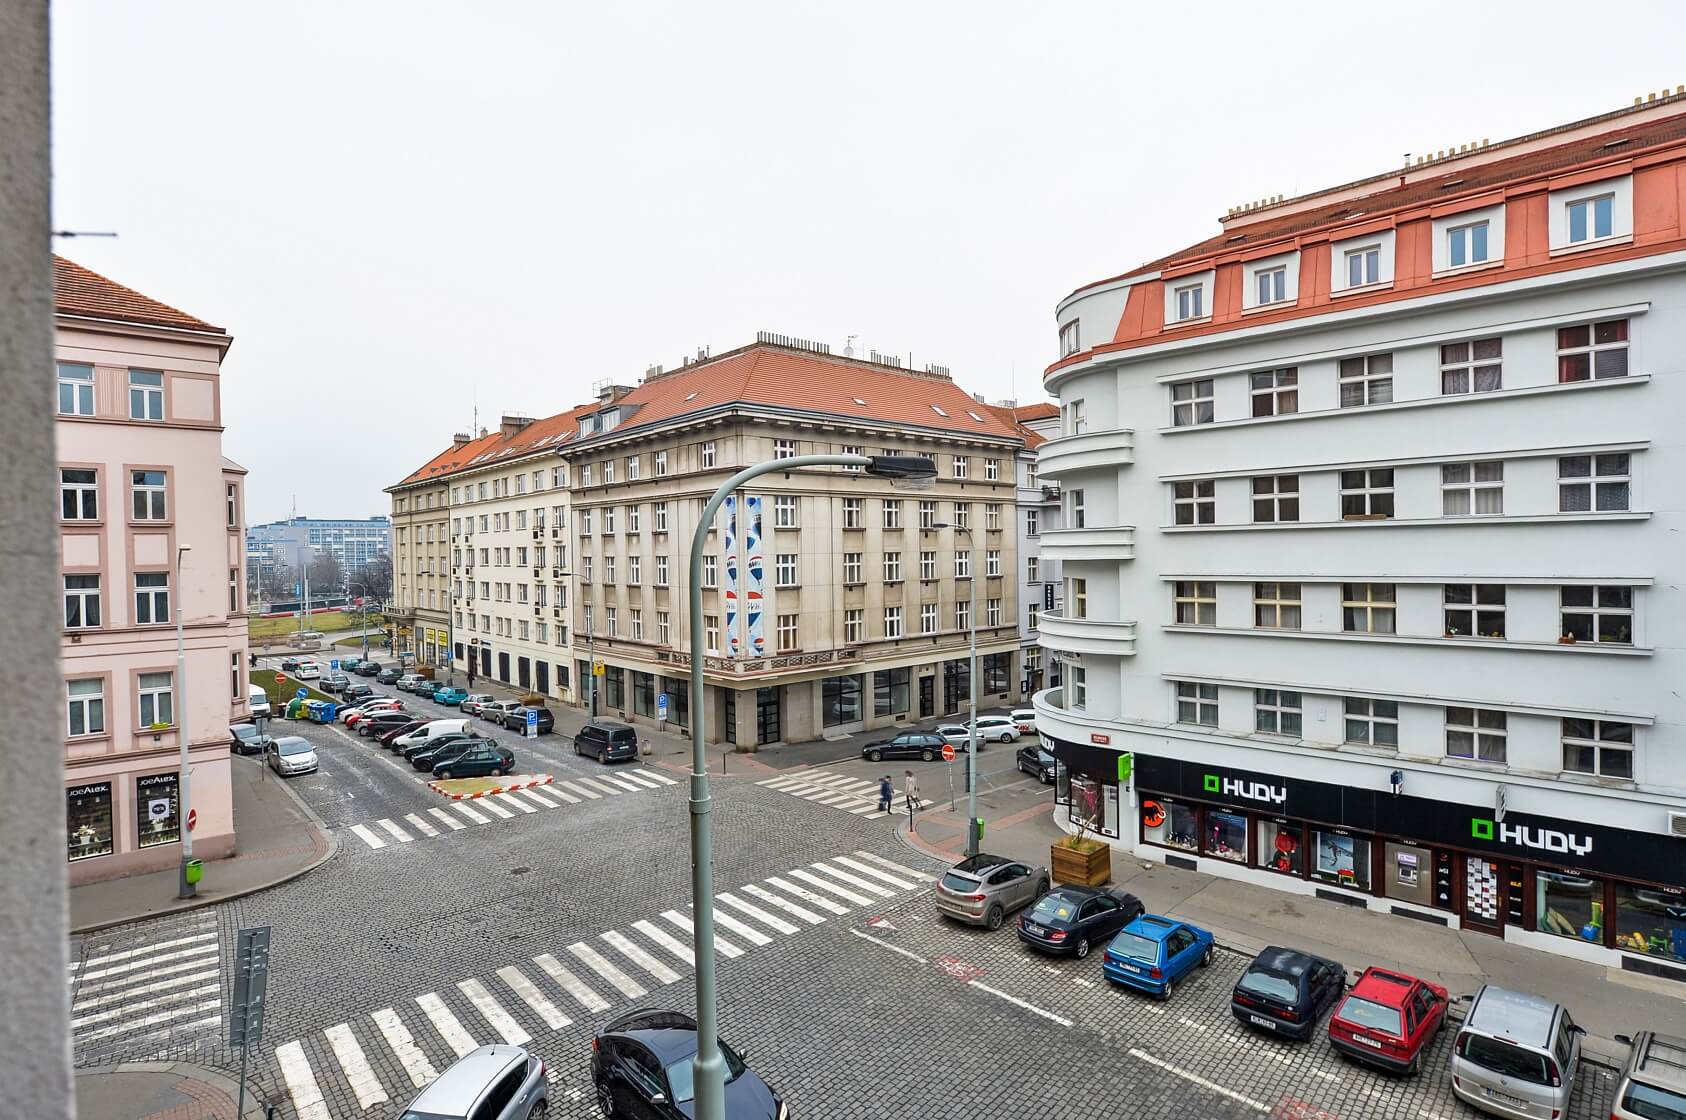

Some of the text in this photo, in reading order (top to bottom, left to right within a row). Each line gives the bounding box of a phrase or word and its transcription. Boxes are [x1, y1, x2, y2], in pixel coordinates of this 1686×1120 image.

[1040, 734, 1055, 752] UDY
[1223, 777, 1287, 804] HUDY
[1500, 822, 1593, 856] HUDY
